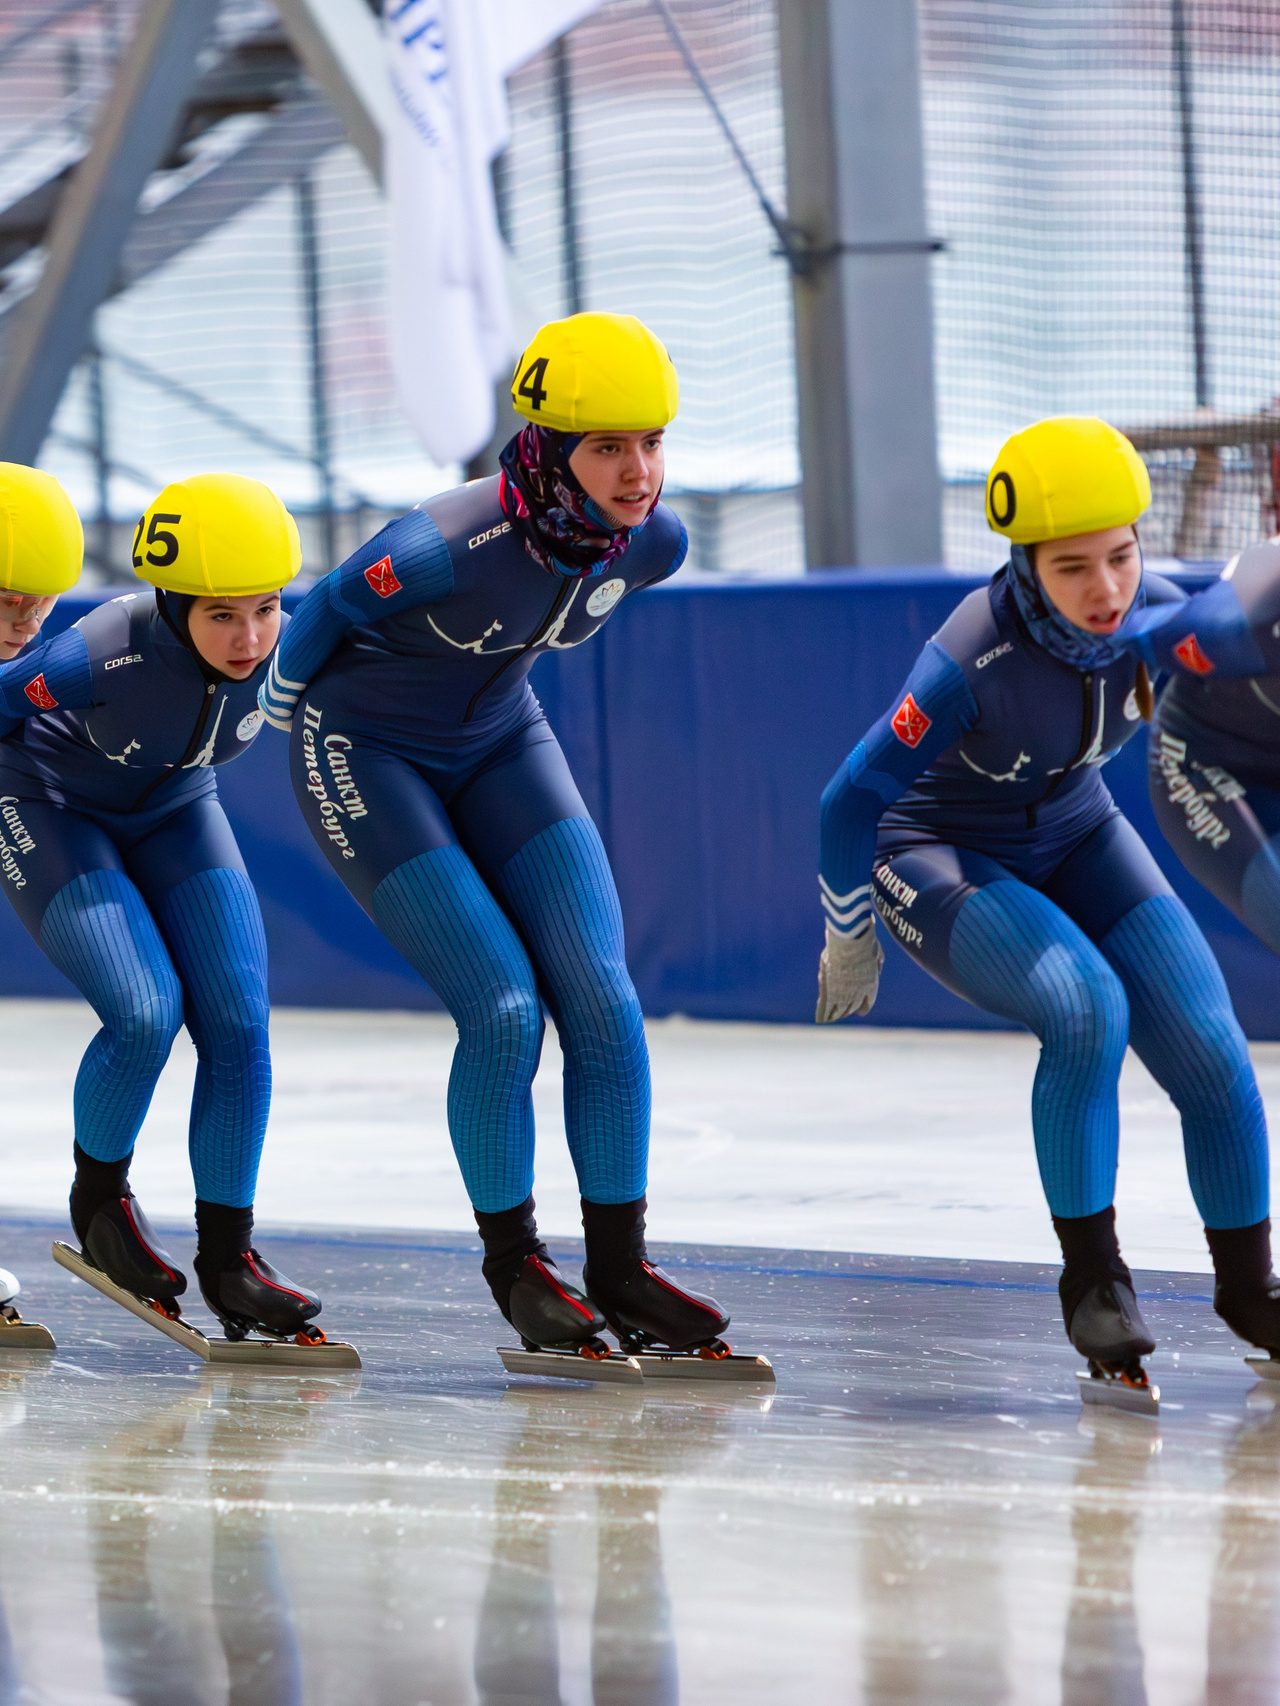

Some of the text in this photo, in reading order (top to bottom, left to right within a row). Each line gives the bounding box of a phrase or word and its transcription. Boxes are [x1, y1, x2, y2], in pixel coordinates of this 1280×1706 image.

[512, 352, 550, 411] 4
[987, 471, 1017, 530] 0
[468, 521, 513, 550] corsa
[104, 654, 144, 671] corsa
[302, 701, 356, 860] Петербург
[323, 733, 369, 821] Санкт
